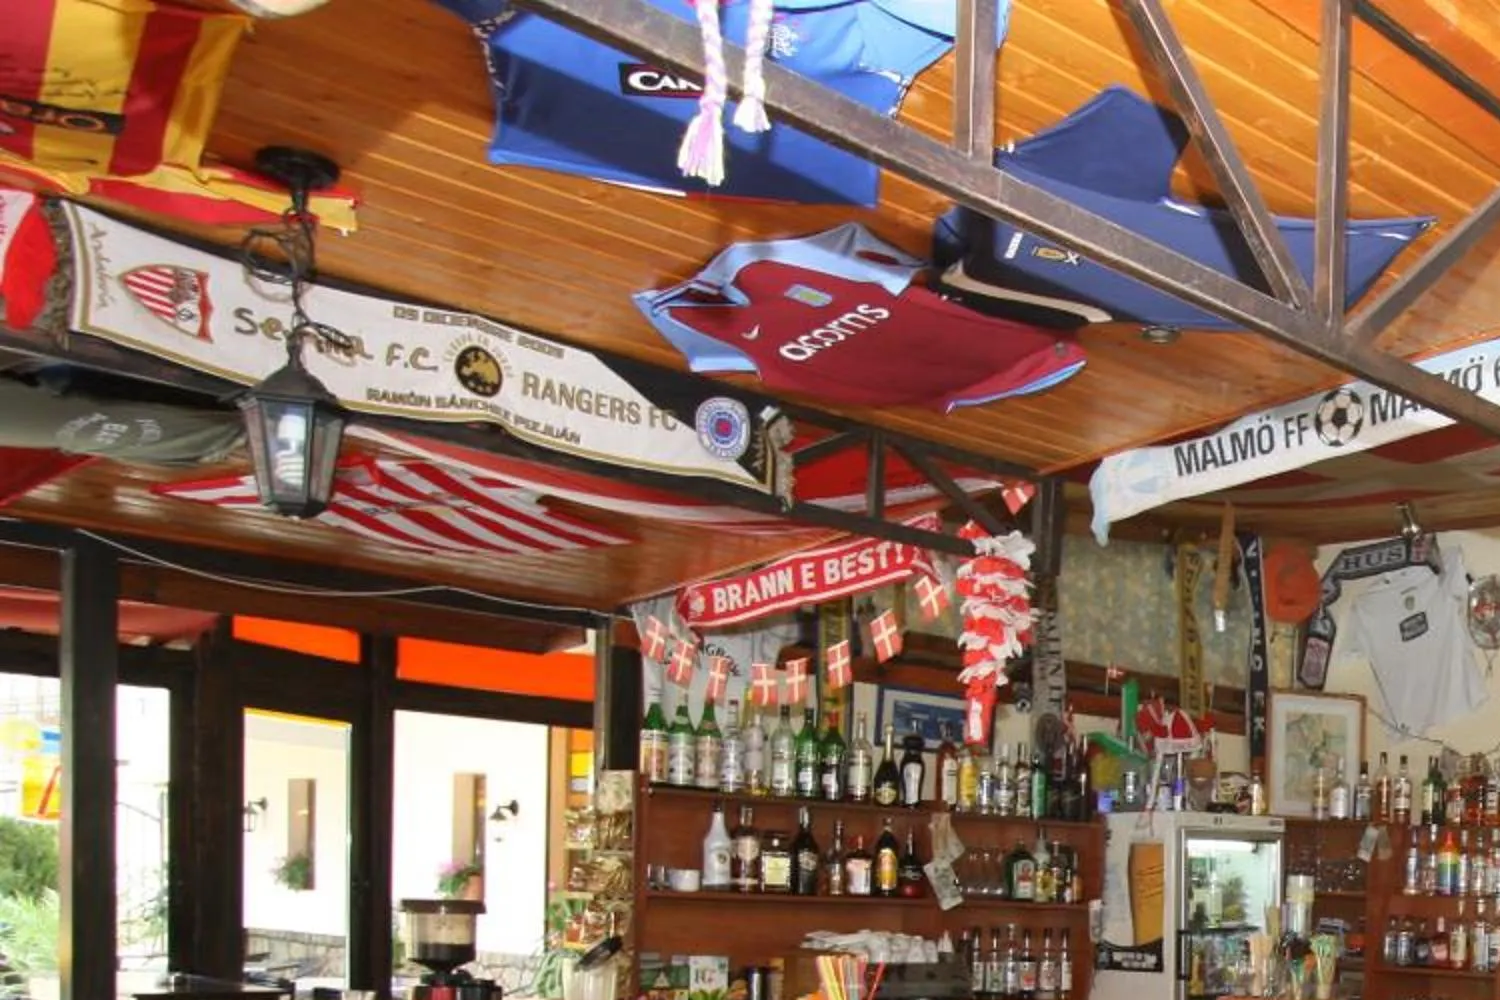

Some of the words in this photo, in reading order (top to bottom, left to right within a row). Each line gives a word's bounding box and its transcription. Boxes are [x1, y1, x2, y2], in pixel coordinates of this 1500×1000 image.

[779, 303, 891, 362] acorns
[522, 371, 643, 426] RANGERS
[648, 403, 679, 432] FC
[1173, 415, 1276, 479] MALMÖ
[1284, 412, 1309, 450] FF
[711, 568, 795, 615] BRANN
[800, 566, 817, 590] E
